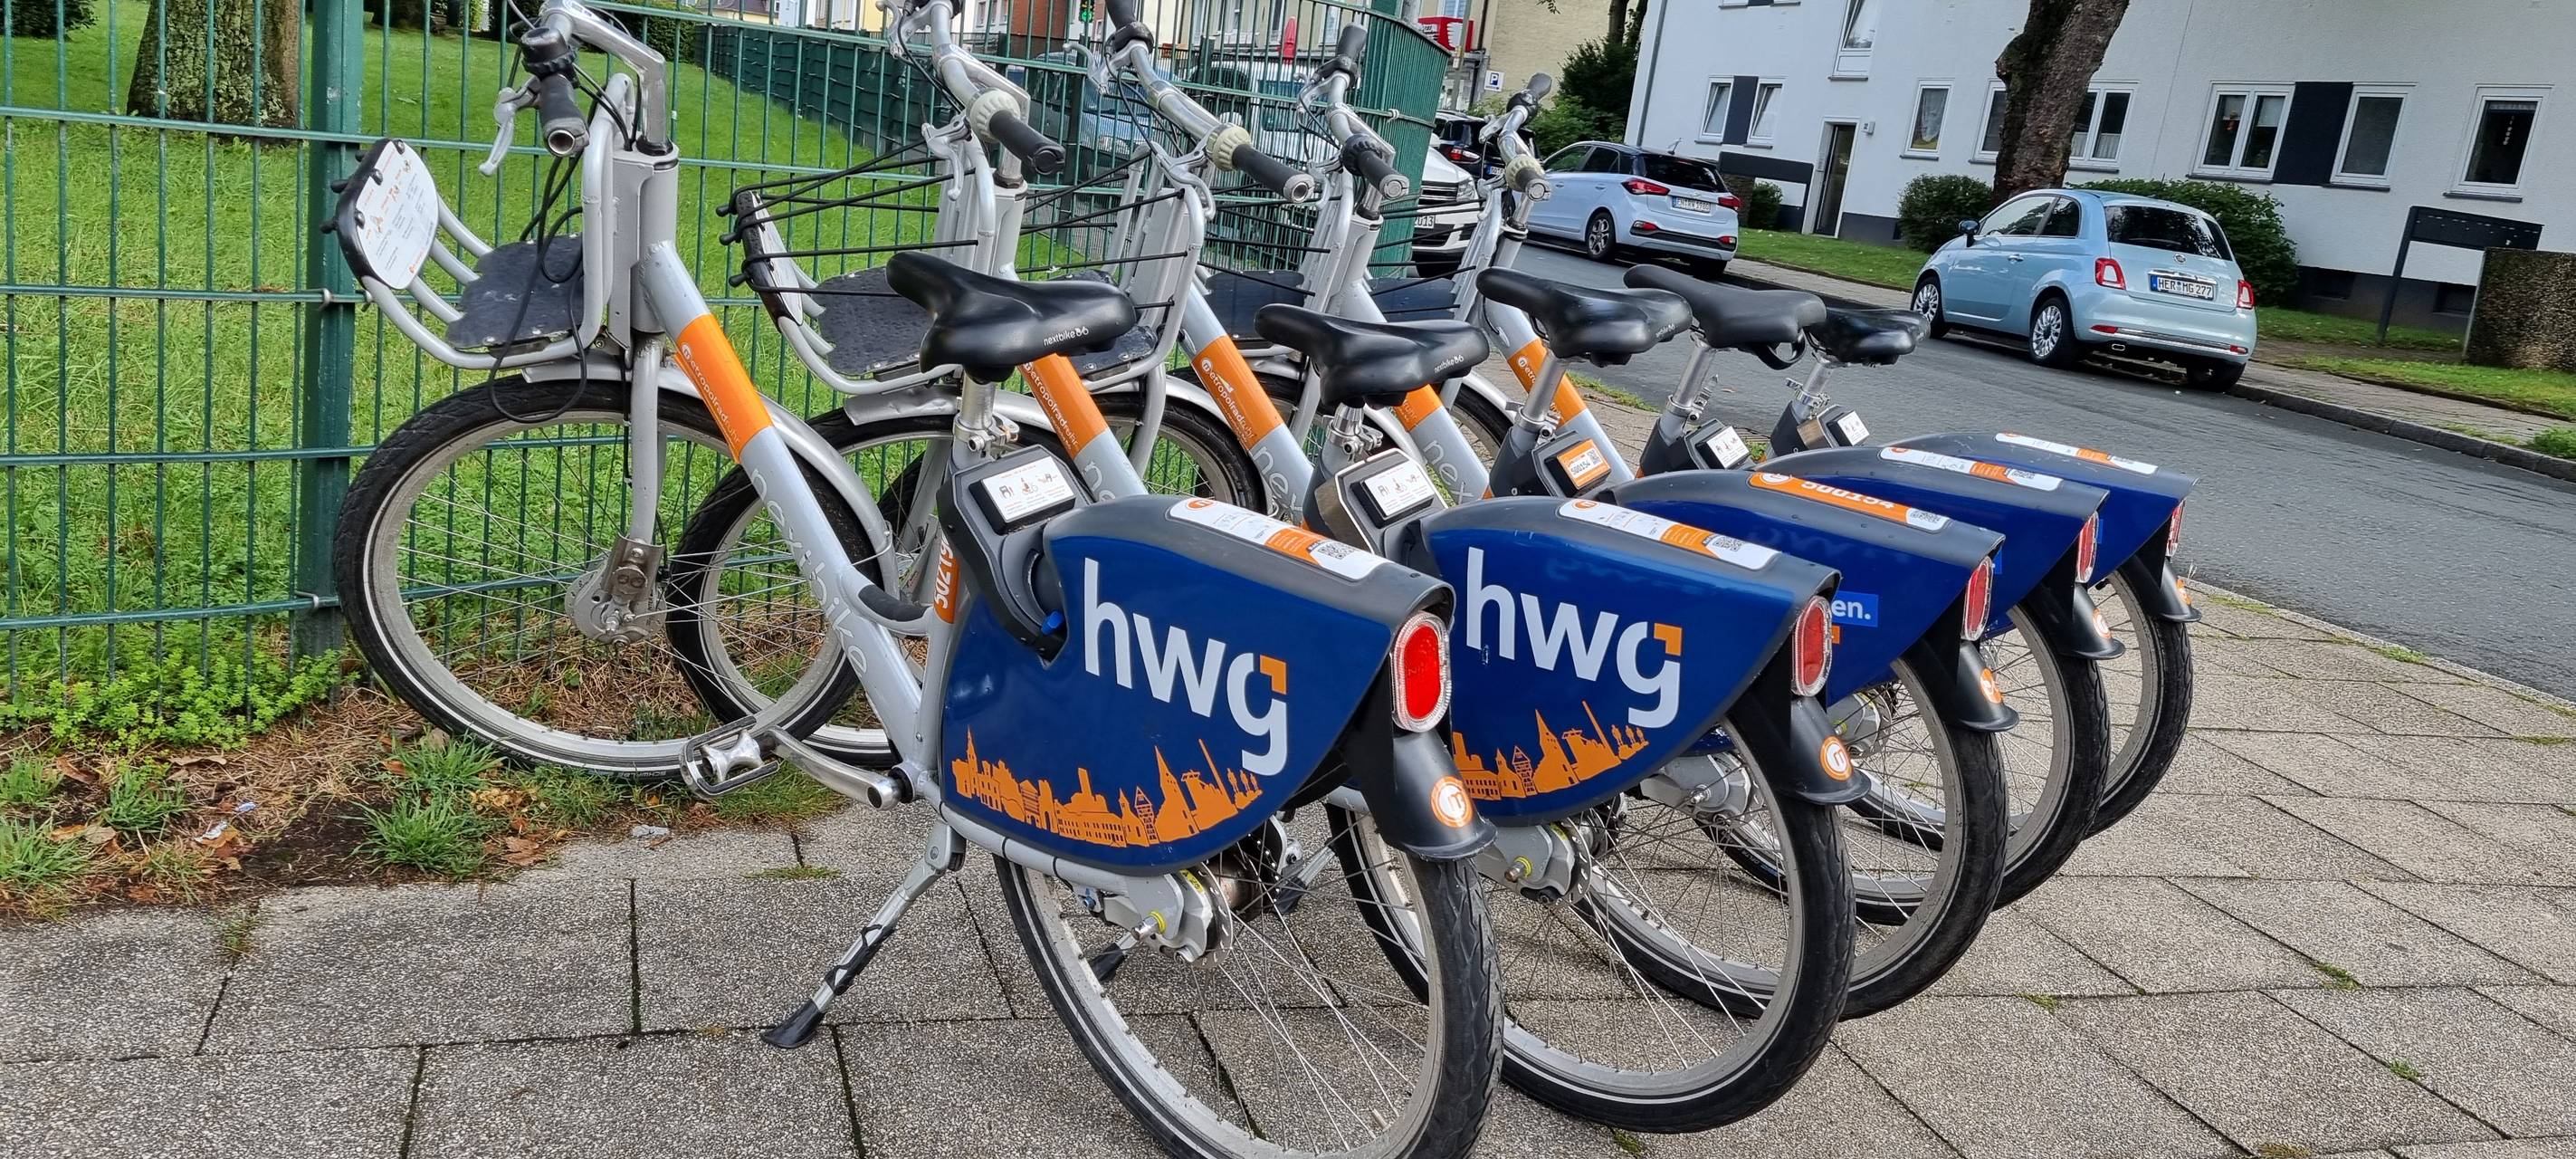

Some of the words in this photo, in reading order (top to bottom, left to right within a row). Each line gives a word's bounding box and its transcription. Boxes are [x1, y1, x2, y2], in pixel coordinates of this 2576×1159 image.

[1044, 330, 1075, 346] nextbike
[2158, 278, 2176, 291] HER
[2181, 282, 2194, 293] MG
[2196, 284, 2212, 297] 277
[750, 468, 868, 679] nextbike
[1831, 599, 1872, 620] en.
[1083, 557, 1288, 777] hwg
[1466, 546, 1683, 729] hwg
